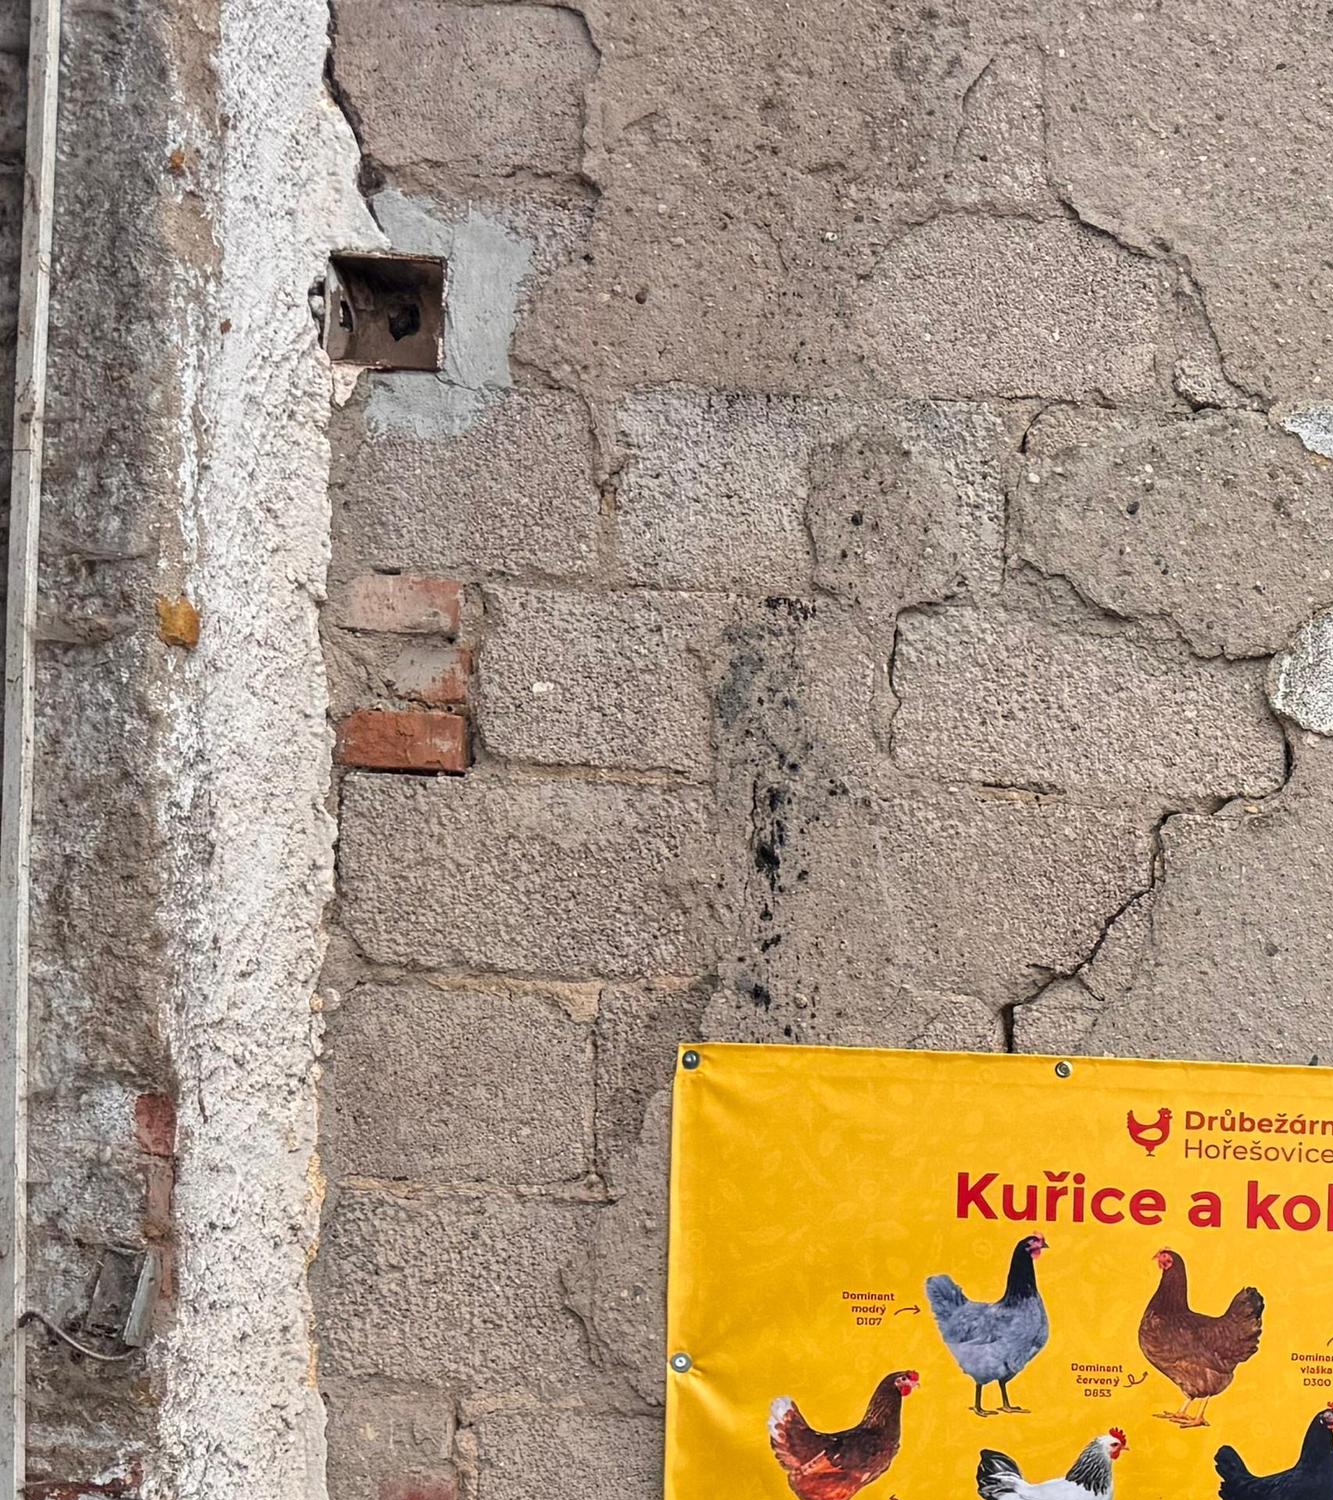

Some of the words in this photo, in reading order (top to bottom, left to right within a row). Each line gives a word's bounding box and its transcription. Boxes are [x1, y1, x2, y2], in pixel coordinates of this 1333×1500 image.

[957, 1170, 1167, 1226] Kuřice
[1188, 1190, 1222, 1228] a
[842, 1291, 895, 1301] Dominant
[851, 1304, 886, 1316] modrý
[856, 1317, 882, 1326] D107
[1071, 1362, 1123, 1373] Dominant
[1300, 1365, 1333, 1375] vlaška
[1076, 1374, 1120, 1387] červený
[1303, 1378, 1332, 1387] D300
